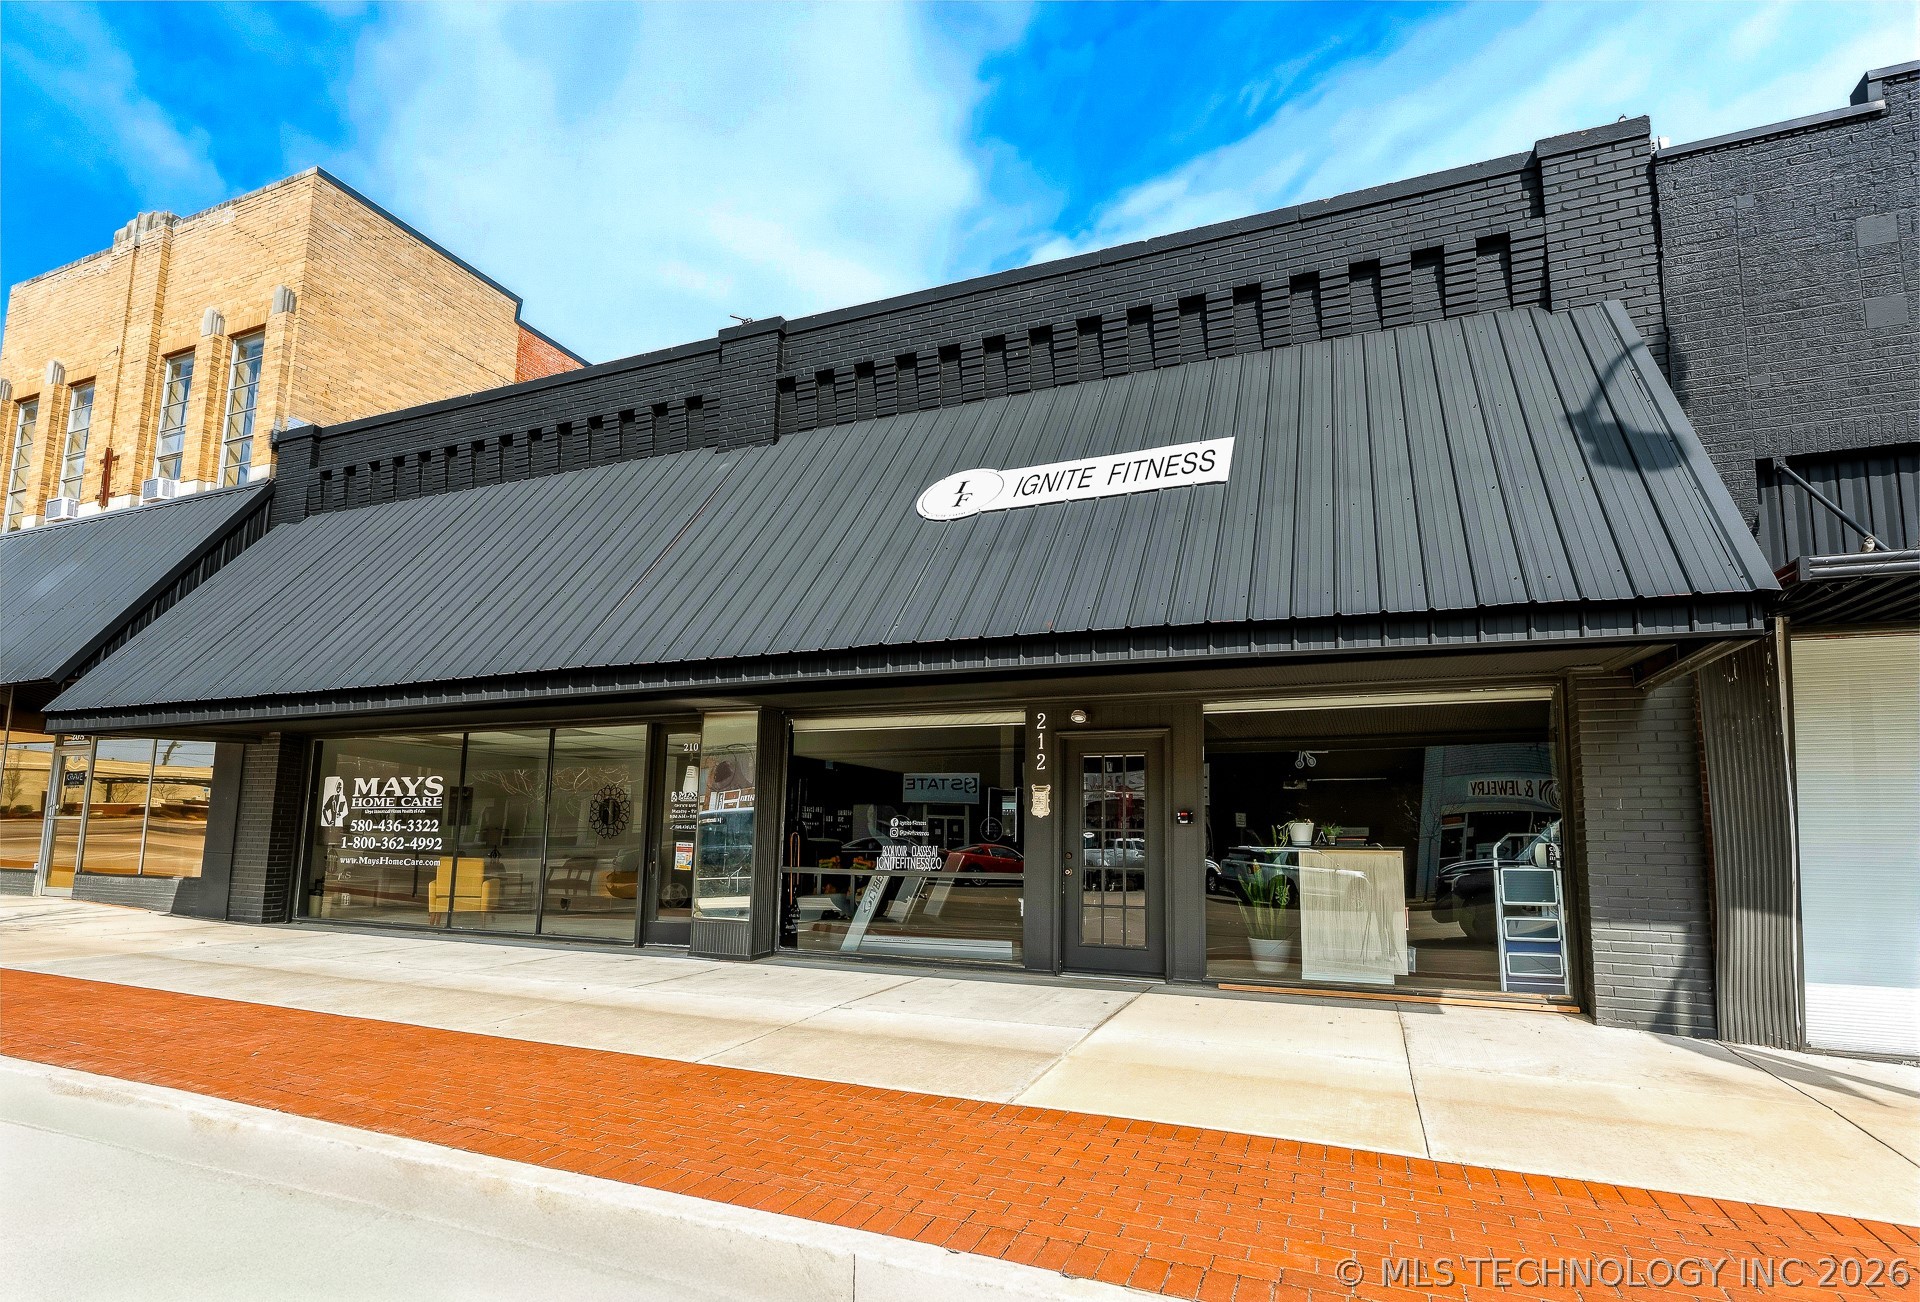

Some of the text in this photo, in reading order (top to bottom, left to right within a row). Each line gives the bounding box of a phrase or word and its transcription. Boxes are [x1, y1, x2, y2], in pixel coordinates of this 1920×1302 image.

[1013, 449, 1216, 498] IGNITE FITNESS
[683, 743, 699, 752] 210
[1036, 712, 1046, 770] 212
[352, 775, 444, 797] MAYS
[351, 797, 443, 807] HOME CARE
[350, 819, 439, 832] 580-436-3322
[341, 836, 443, 850] 1-800-362-4992
[340, 856, 441, 866] www.MaysHomeCare.com
[869, 875, 886, 902] CYBE
